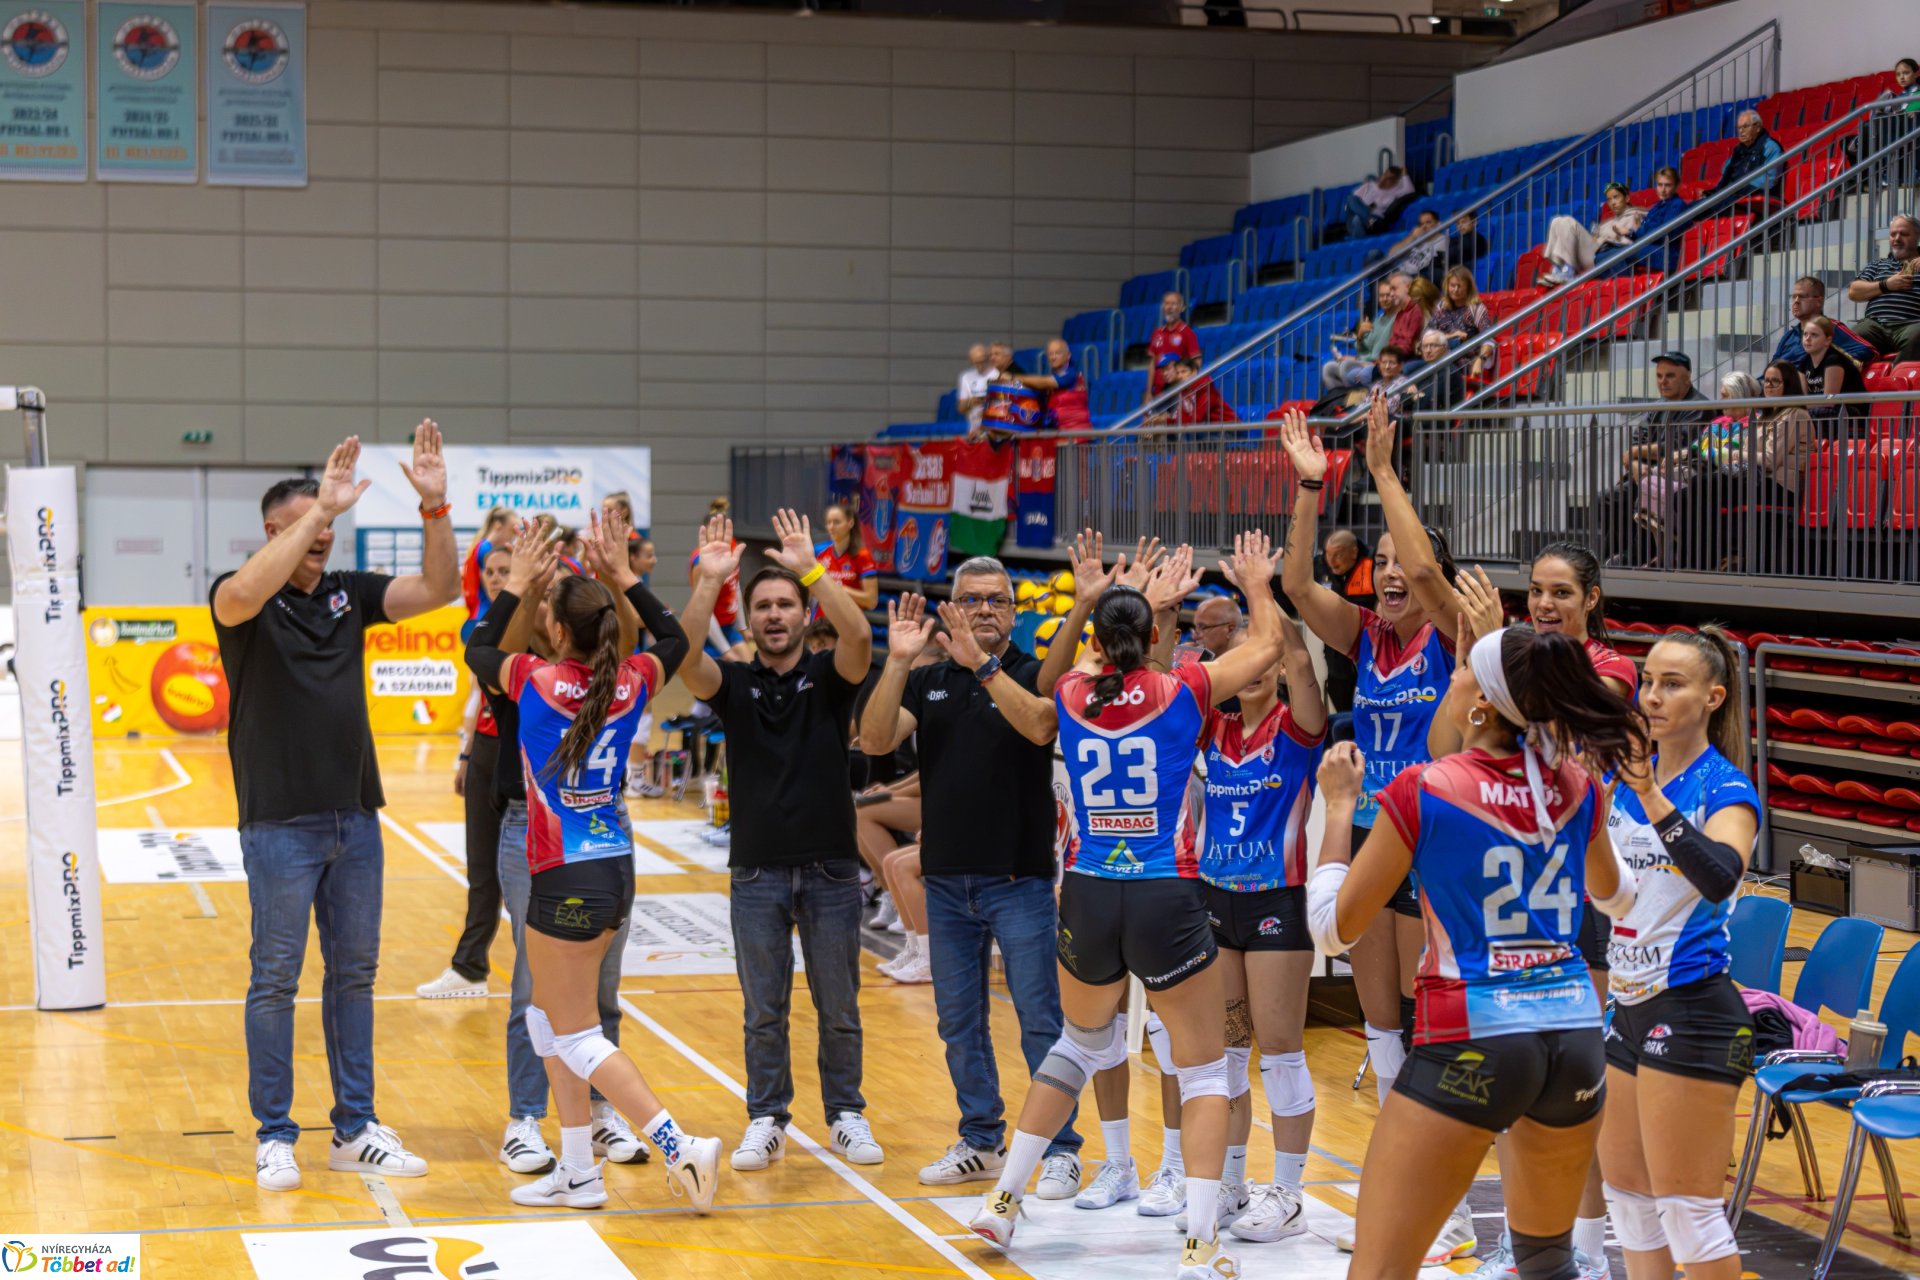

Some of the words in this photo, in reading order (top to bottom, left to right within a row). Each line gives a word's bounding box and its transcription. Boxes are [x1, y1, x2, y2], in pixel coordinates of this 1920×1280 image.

[477, 466, 583, 486] TippmixPRO
[477, 493, 581, 509] EXTRALIGA
[365, 624, 456, 653] velina
[379, 682, 387, 692] A
[391, 681, 453, 692] SZÁDBAN
[51, 678, 77, 797] TippmixPRO
[1370, 712, 1403, 752] 17
[1078, 736, 1158, 807] 23
[1205, 773, 1282, 798] ippmixPRO
[1091, 816, 1155, 830] STRABAG
[1229, 801, 1249, 837] 5
[1483, 844, 1577, 937] 24
[62, 851, 87, 970] TippmixPRO
[555, 902, 592, 926] EAK
[1145, 951, 1207, 985] TippmixPRO
[1440, 1063, 1495, 1098] EAK
[650, 1118, 673, 1146] UST
